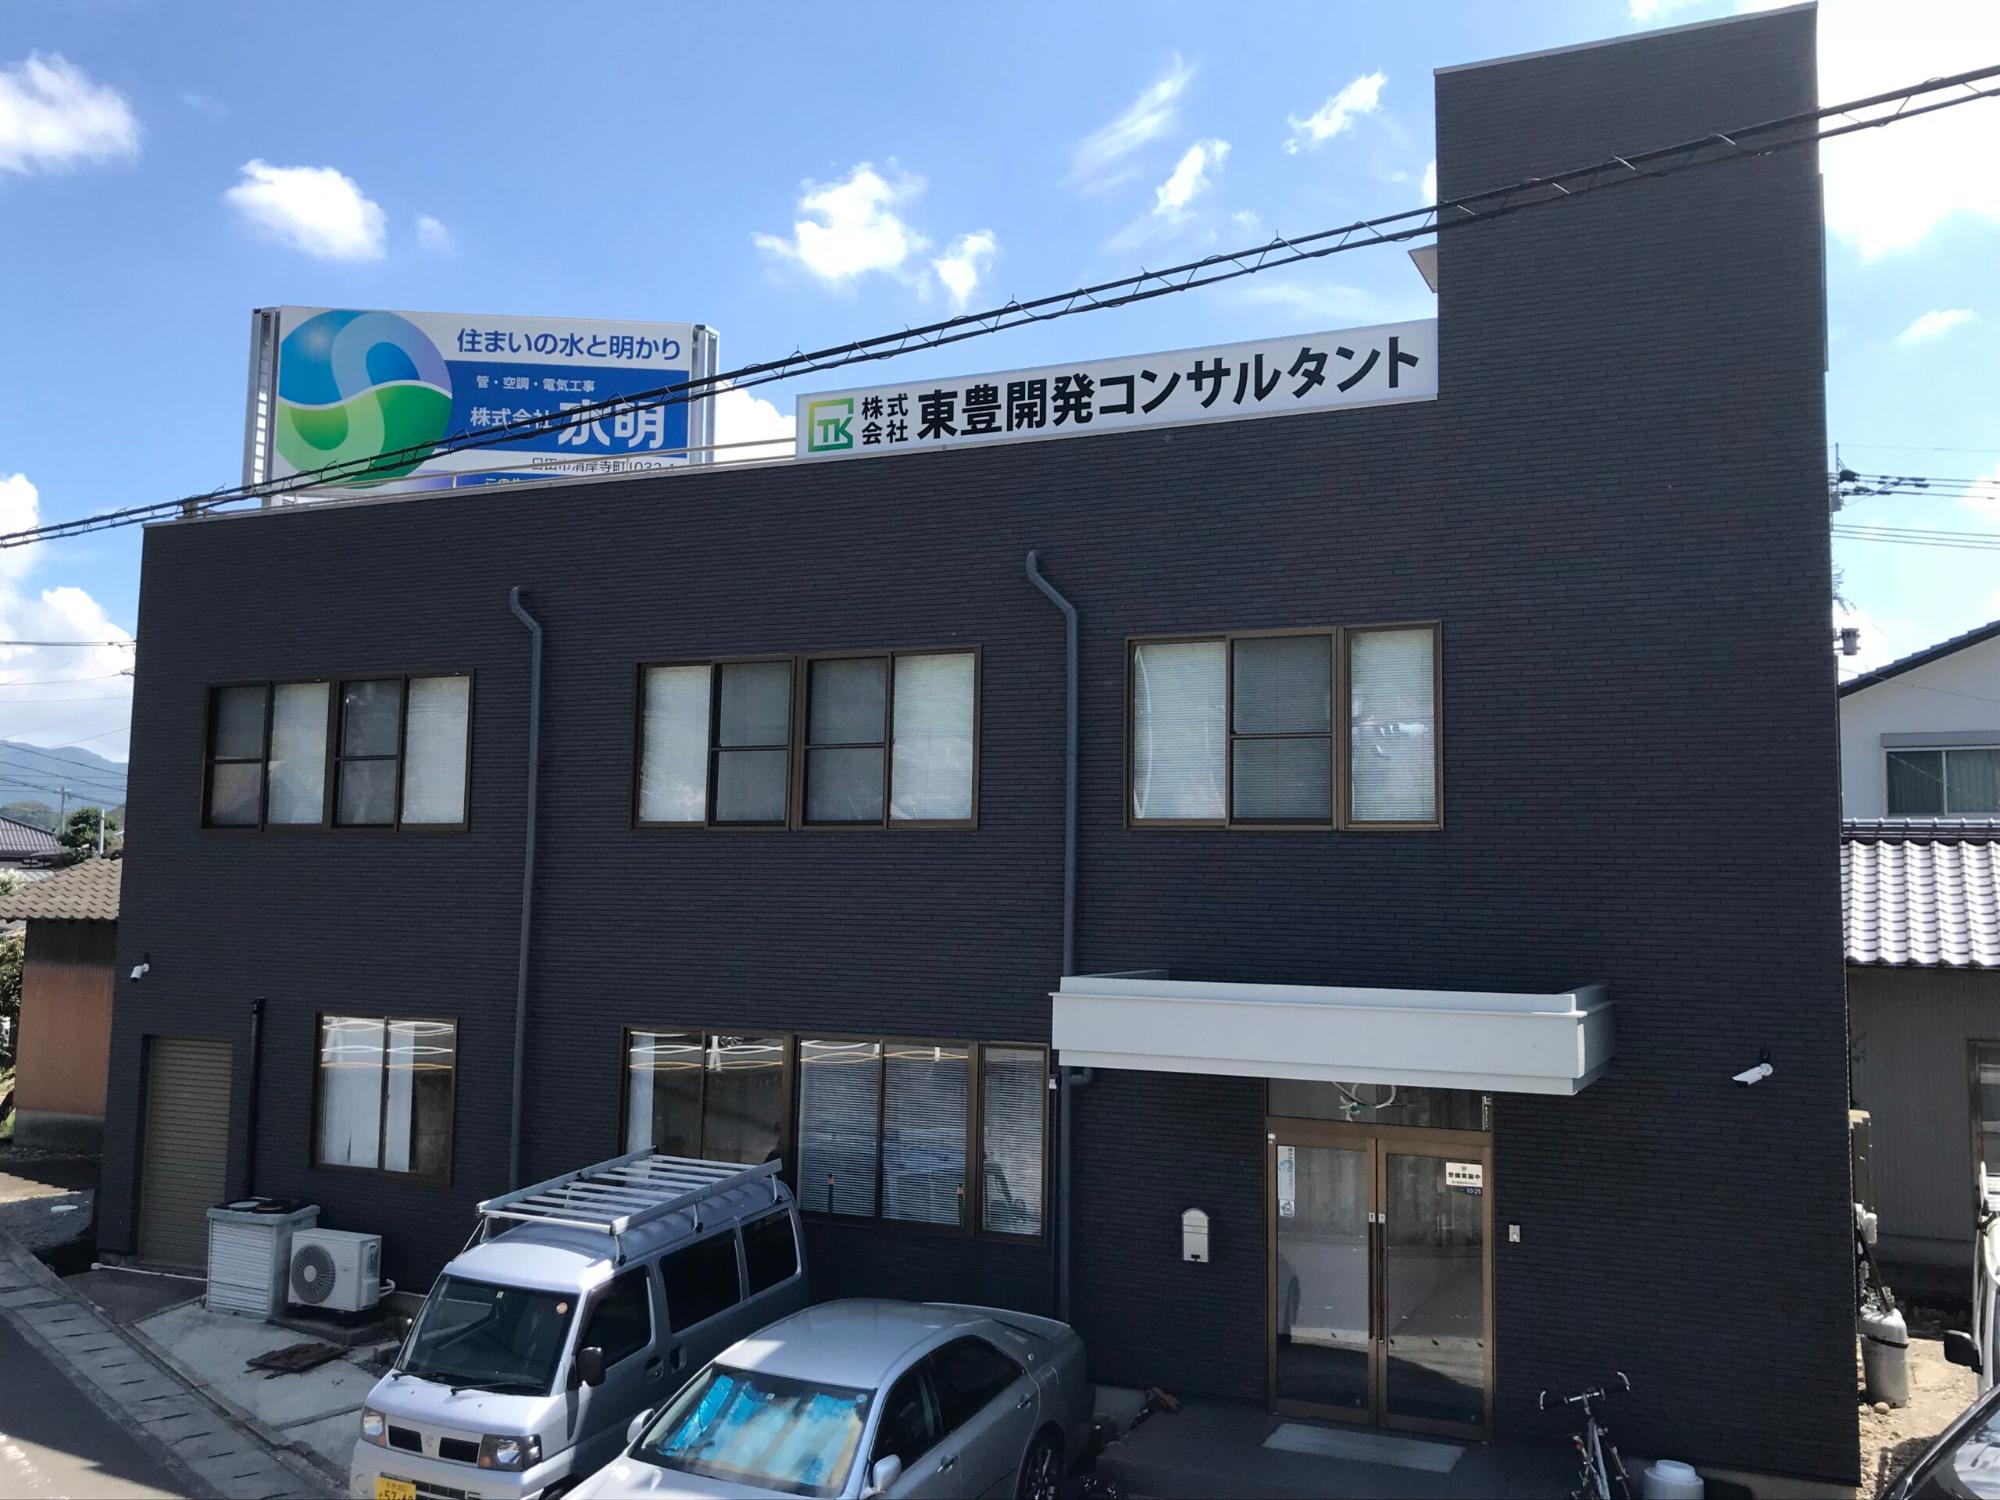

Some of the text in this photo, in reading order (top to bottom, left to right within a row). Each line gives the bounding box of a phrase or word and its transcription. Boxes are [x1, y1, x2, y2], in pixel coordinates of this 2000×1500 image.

[457, 327, 681, 360] 住まいの水と明かり
[476, 375, 596, 393] 管・空調・電気工事
[916, 336, 1420, 440] 東豊開発コンサルタント
